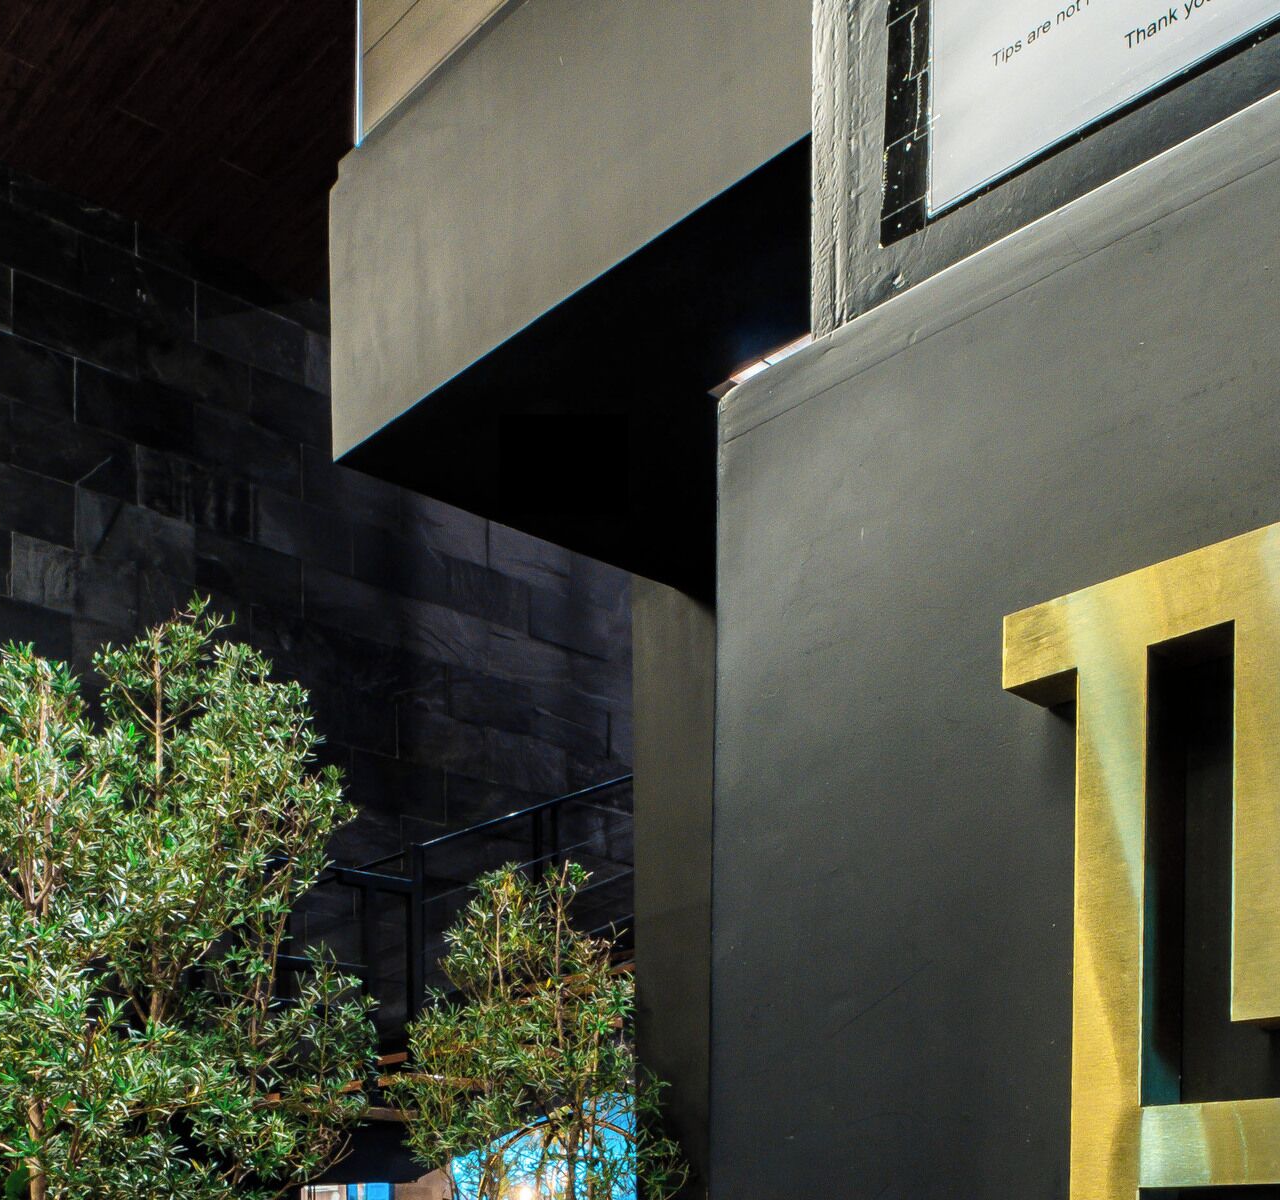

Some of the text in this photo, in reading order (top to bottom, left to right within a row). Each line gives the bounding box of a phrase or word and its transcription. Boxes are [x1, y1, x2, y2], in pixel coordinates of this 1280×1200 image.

[992, 0, 1081, 66] Tips are not
[1124, 0, 1211, 49] Thank yo
